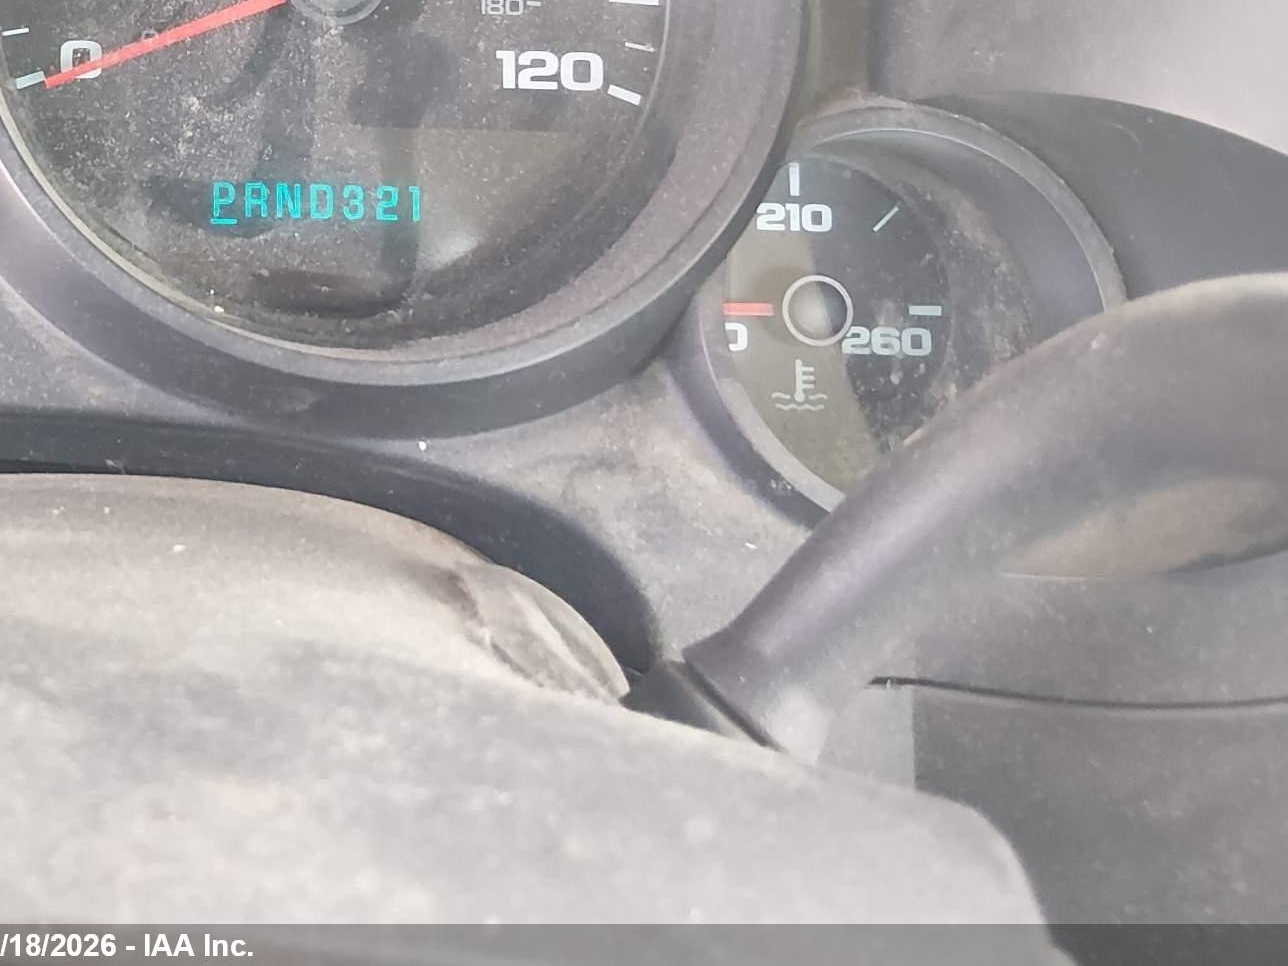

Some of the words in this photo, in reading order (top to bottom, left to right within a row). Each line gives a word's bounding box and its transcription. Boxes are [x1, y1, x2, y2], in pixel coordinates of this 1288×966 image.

[59, 40, 103, 79] 0
[495, 50, 604, 91] 120
[755, 202, 833, 232] 210
[841, 326, 932, 356] 260
